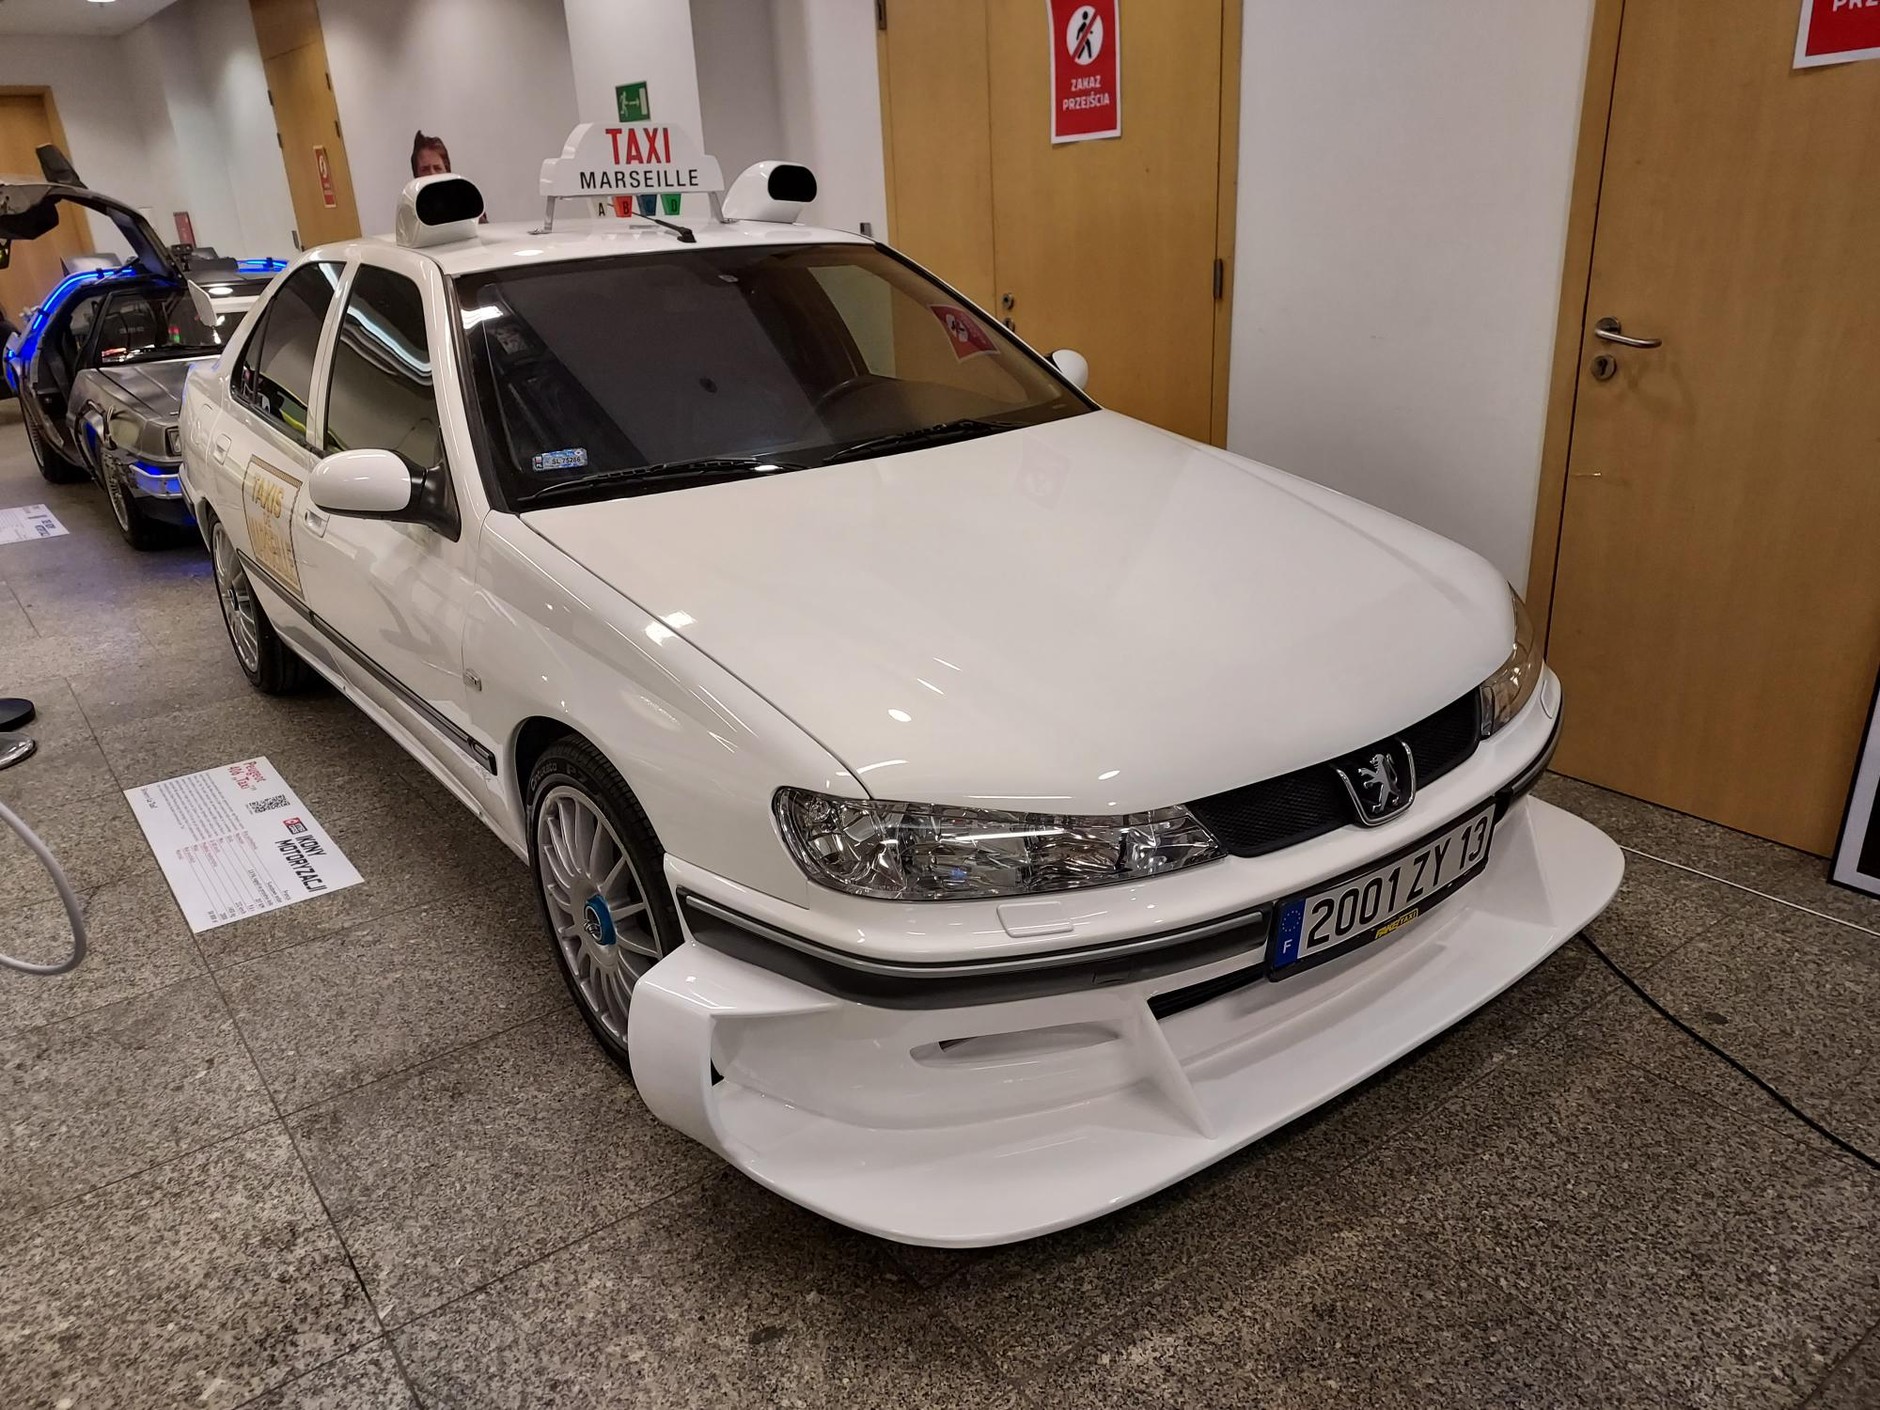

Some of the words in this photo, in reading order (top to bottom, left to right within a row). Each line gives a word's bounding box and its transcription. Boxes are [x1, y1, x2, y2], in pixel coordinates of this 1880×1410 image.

[1072, 75, 1101, 91] ZAKAZ
[1063, 92, 1110, 111] PRZEJŚCIA
[605, 127, 672, 165] TAXI
[580, 169, 699, 190] MARSEILLE
[599, 203, 606, 216] A
[623, 201, 630, 215] B
[671, 199, 678, 212] D
[251, 476, 284, 519] TAXIS
[228, 765, 243, 776] 406
[243, 761, 267, 783] Peugeot
[295, 834, 327, 857] IKONY
[274, 839, 328, 893] MOTORYZACJI
[1306, 867, 1402, 949] 2001
[1406, 837, 1451, 903] ZY
[1459, 816, 1488, 870] 13
[1282, 938, 1293, 954] F
